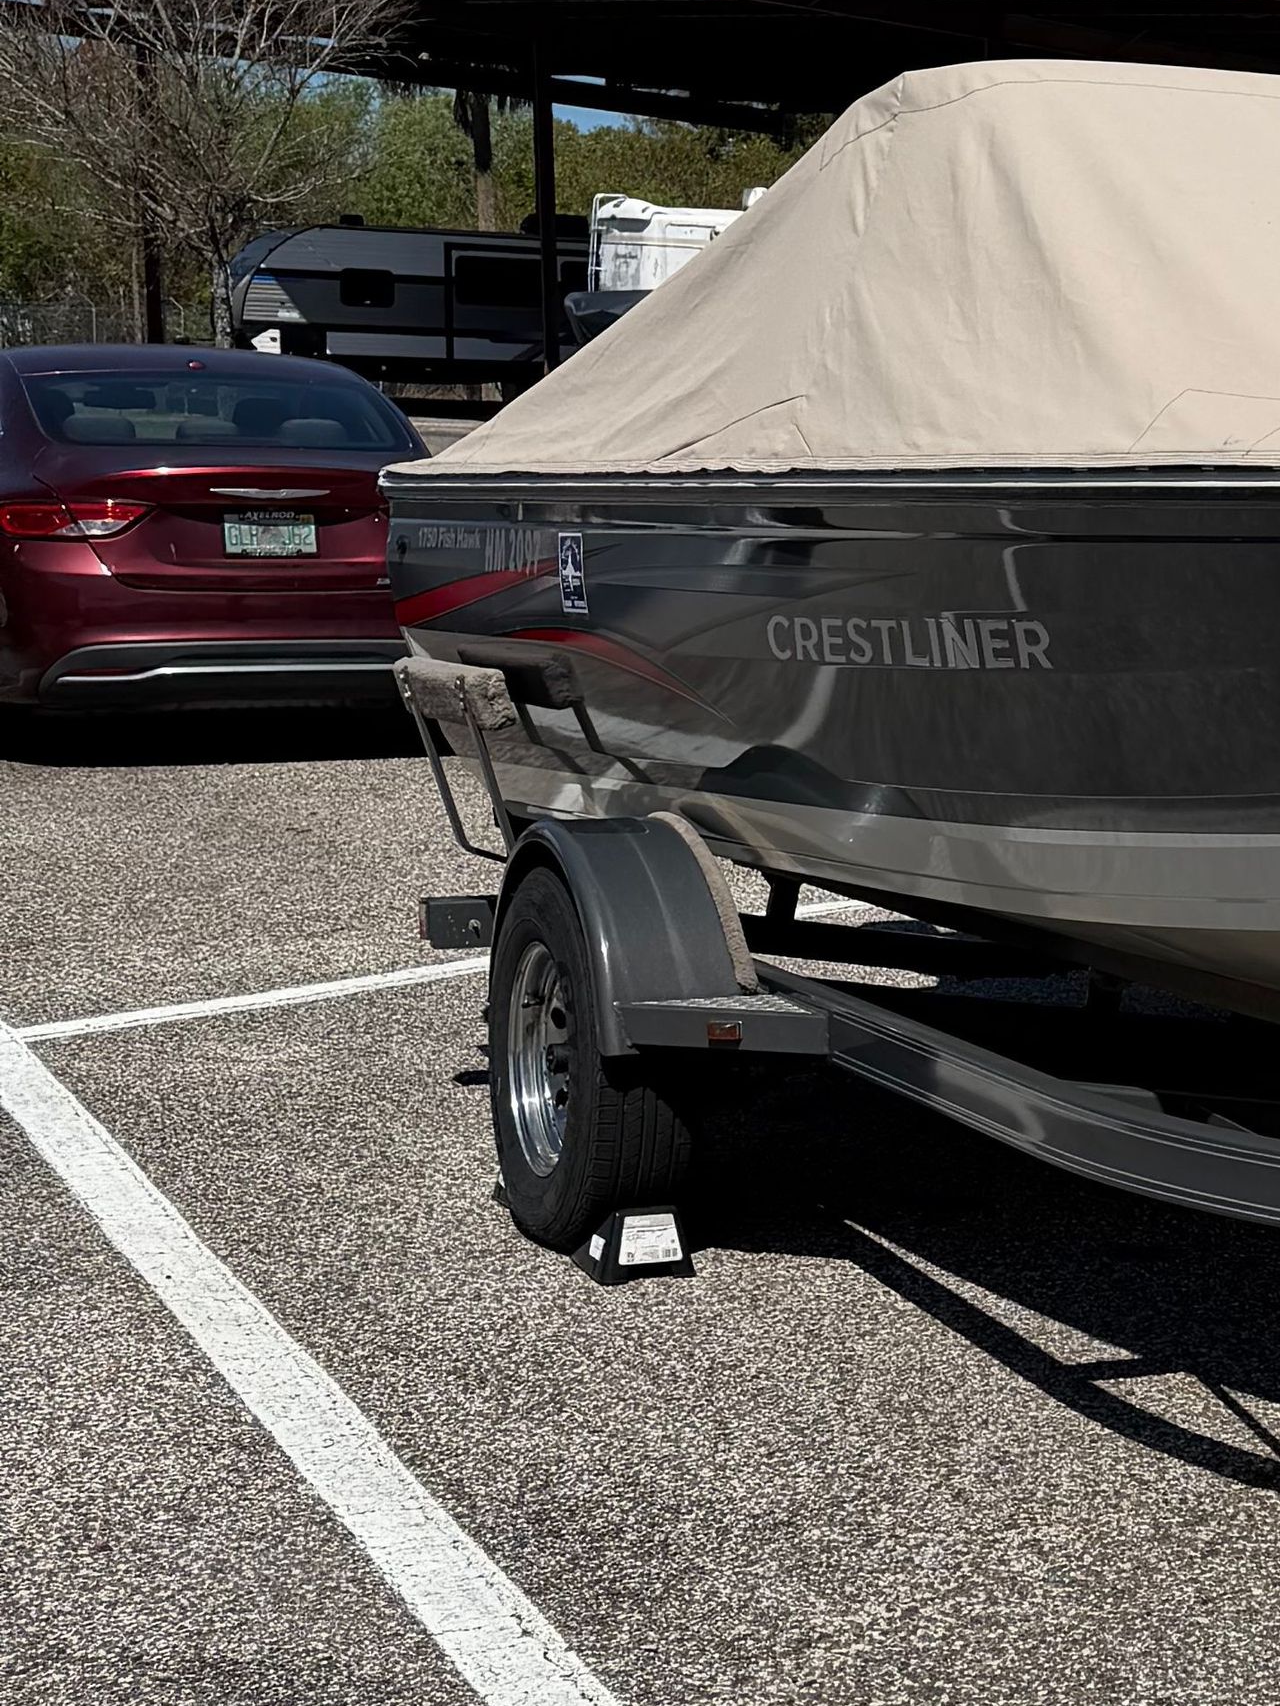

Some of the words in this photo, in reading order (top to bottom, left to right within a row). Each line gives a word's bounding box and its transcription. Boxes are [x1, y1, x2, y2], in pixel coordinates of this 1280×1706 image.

[418, 526, 438, 548] 1750
[438, 526, 456, 549] Fish
[456, 527, 481, 550] Hawk
[766, 614, 1054, 669] CRESTLINER
